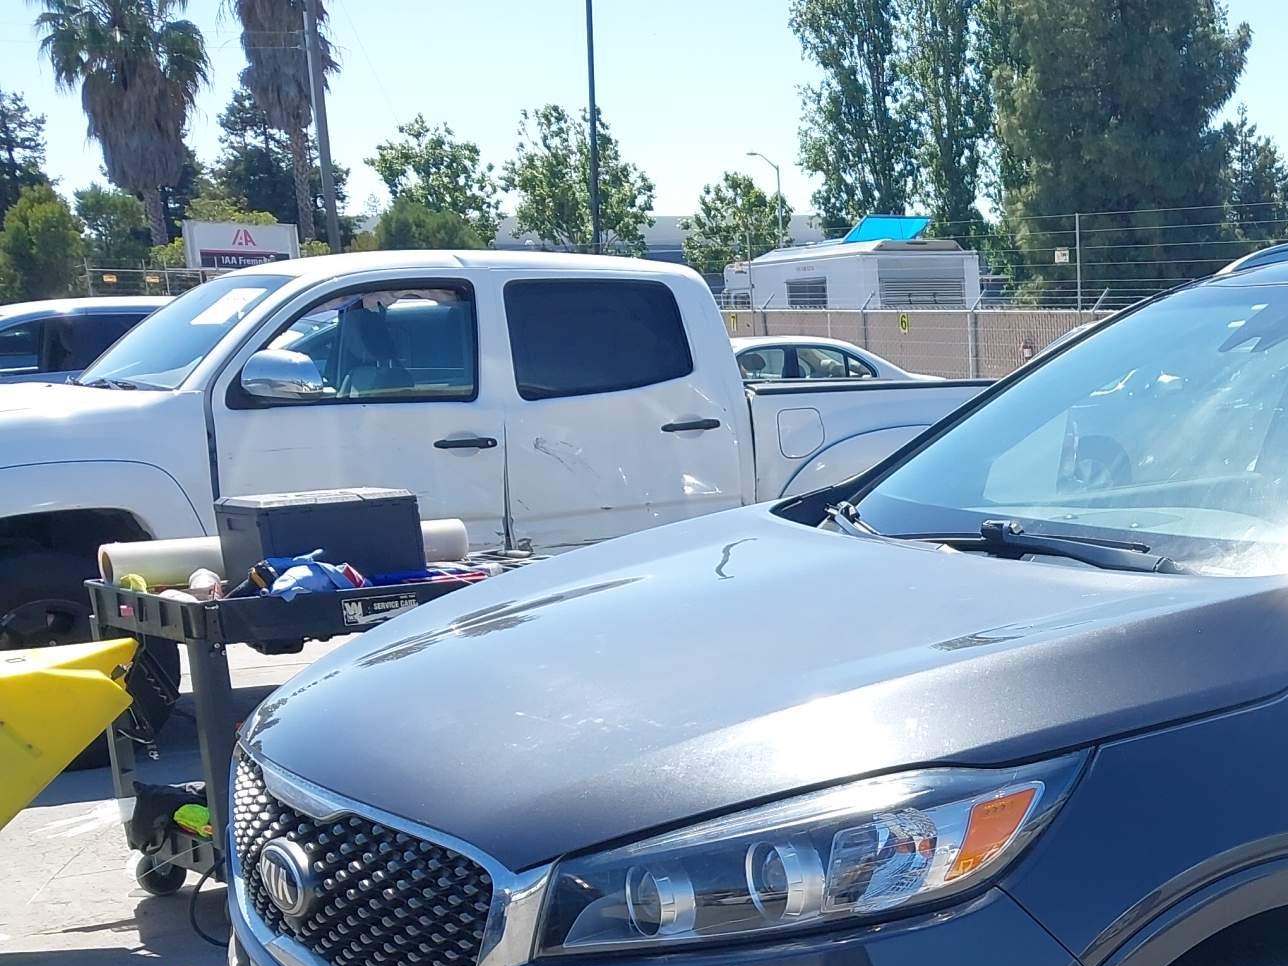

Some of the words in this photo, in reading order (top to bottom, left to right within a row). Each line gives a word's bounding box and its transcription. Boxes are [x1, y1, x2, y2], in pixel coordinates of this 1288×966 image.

[221, 256, 238, 265] IAA
[900, 314, 909, 331] 6
[373, 600, 399, 611] SERVICE
